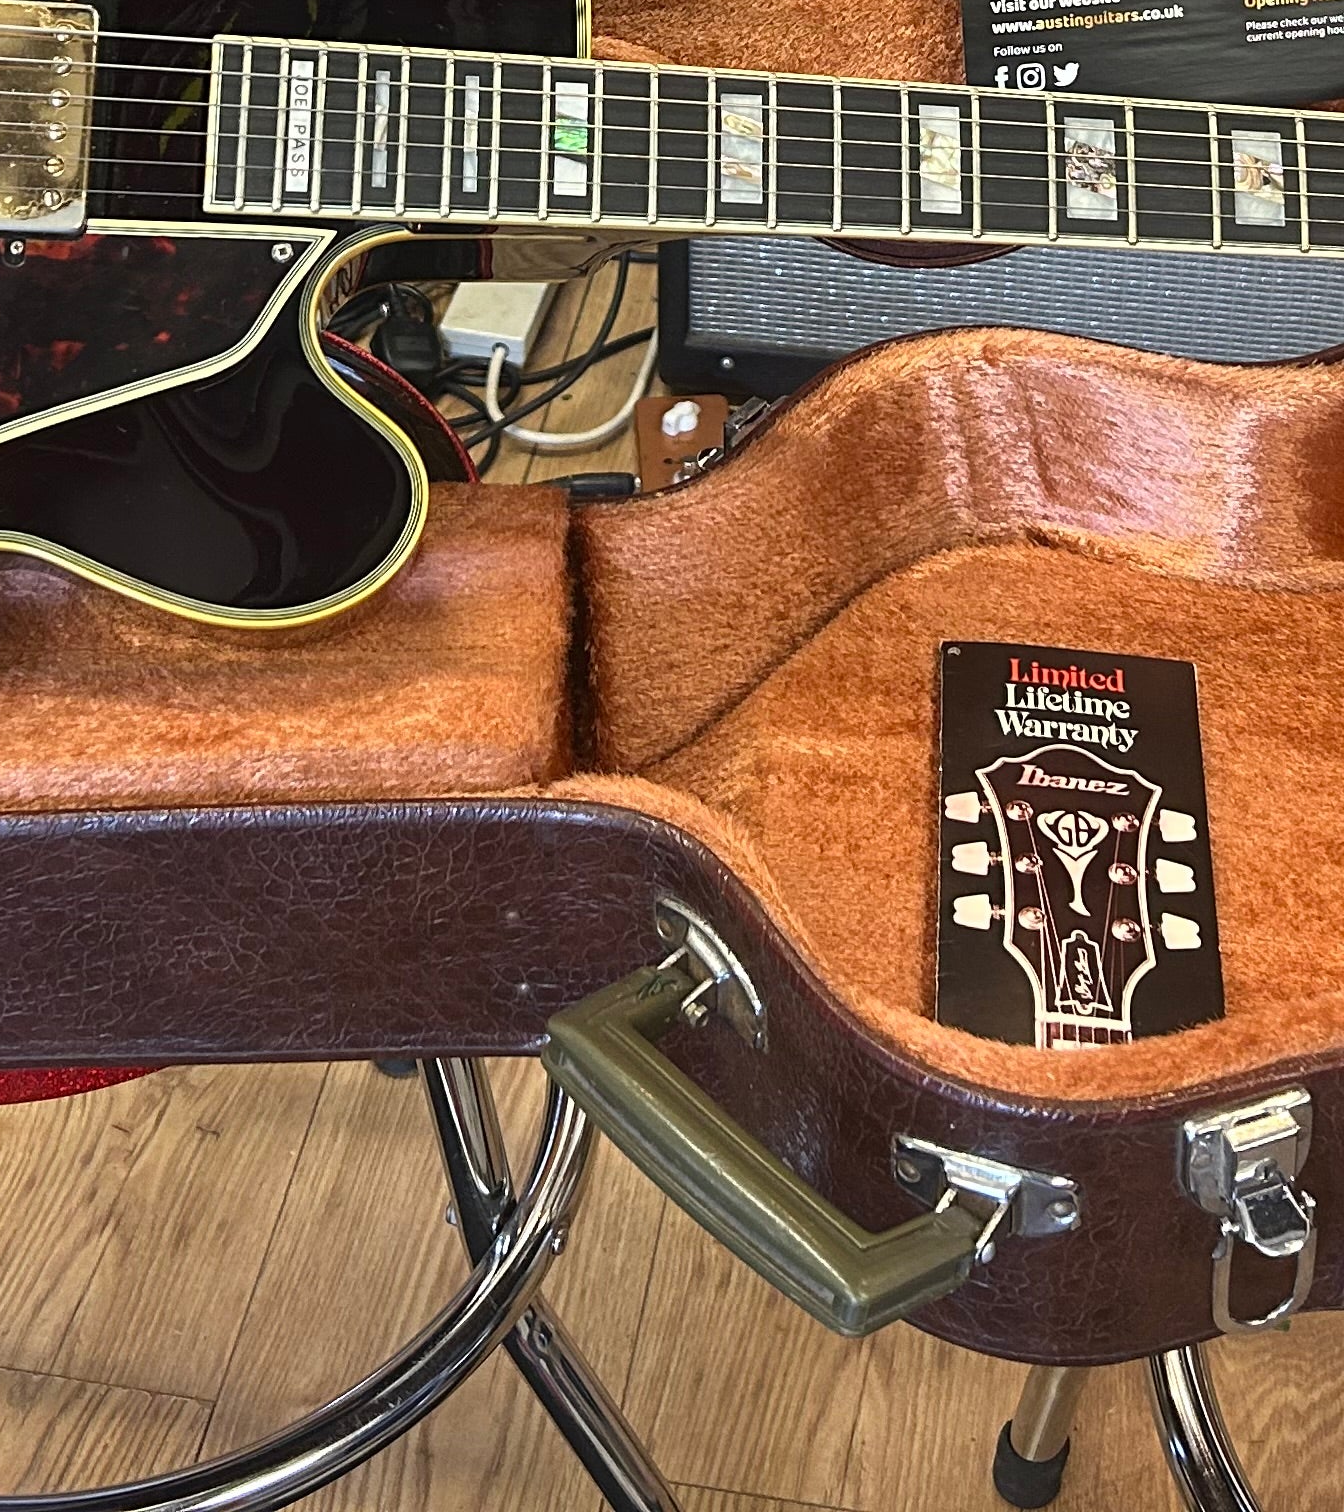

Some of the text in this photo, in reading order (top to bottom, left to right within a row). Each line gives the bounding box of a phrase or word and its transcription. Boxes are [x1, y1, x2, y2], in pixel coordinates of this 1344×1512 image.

[991, 4, 1185, 35] www.austinguitars.co.uk
[1245, 19, 1278, 32] Please
[1280, 16, 1309, 29] check
[1310, 16, 1328, 26] our
[1246, 30, 1284, 43] current
[1284, 27, 1326, 40] opening
[993, 42, 1063, 58] Follow us on
[290, 74, 309, 179] JOE PASS
[1009, 658, 1125, 693] Limited
[1005, 683, 1131, 722] Lifetime
[994, 709, 1139, 753] Warranty
[1016, 764, 1130, 796] Ibanez
